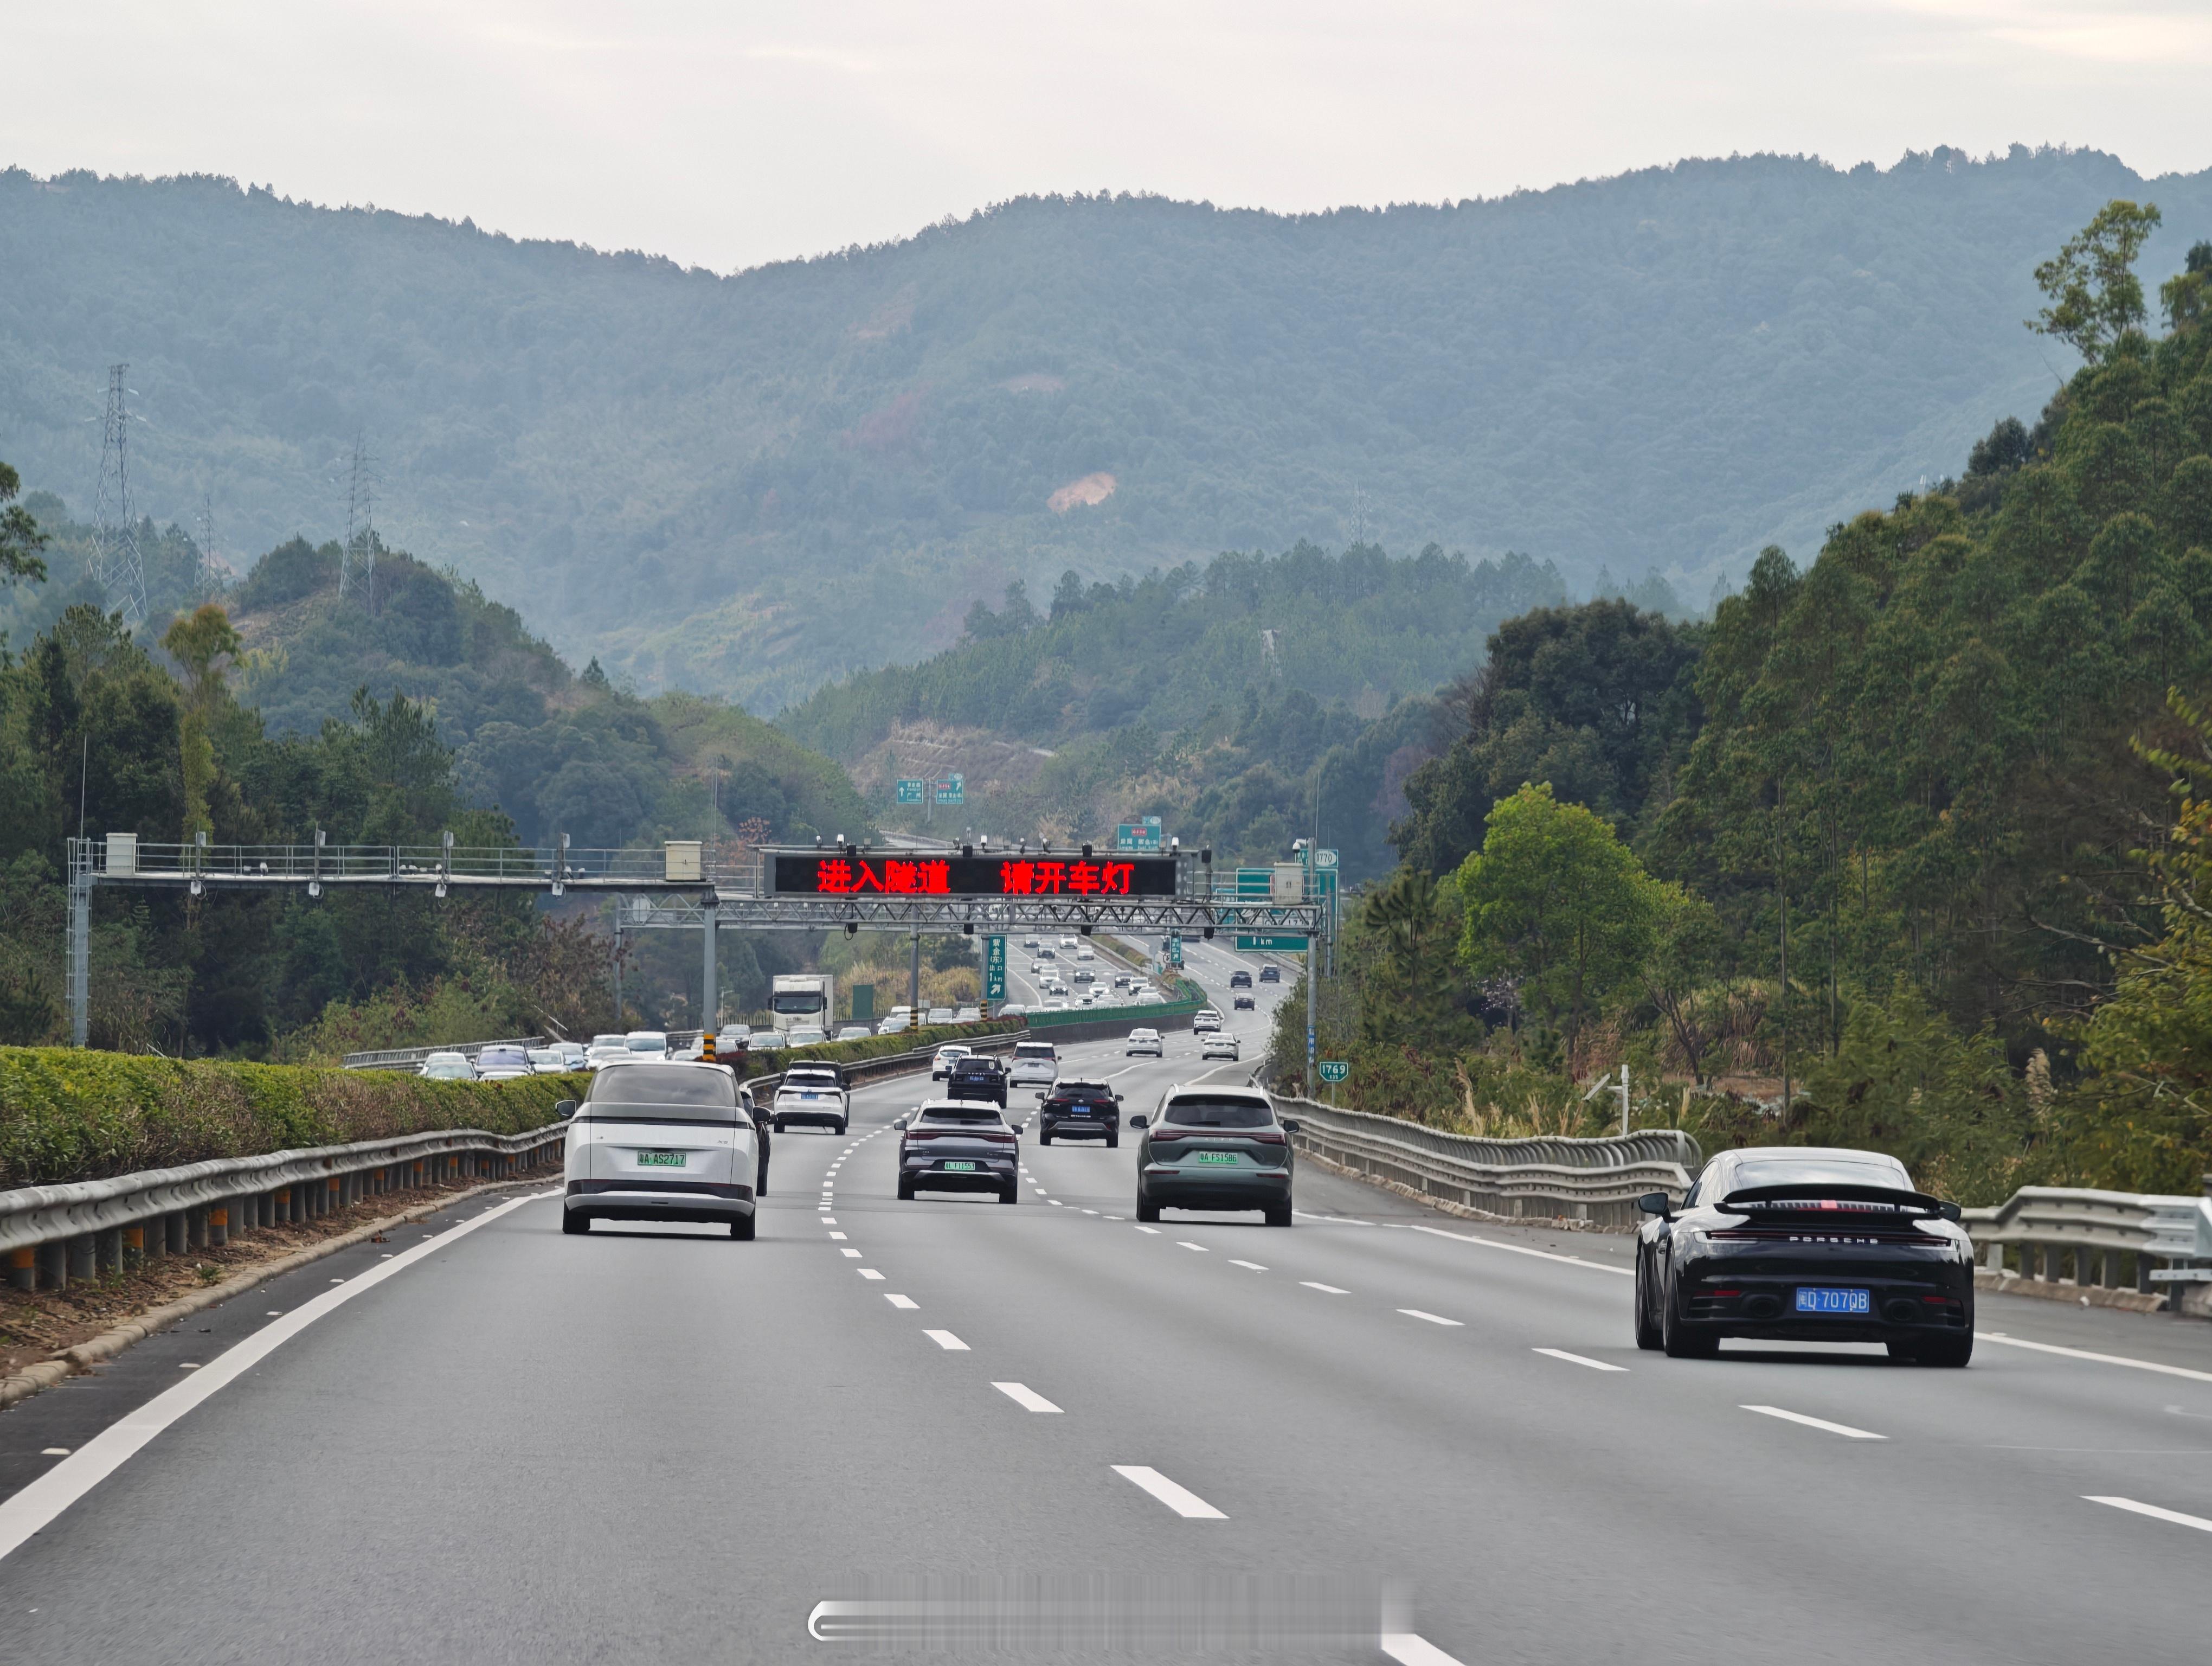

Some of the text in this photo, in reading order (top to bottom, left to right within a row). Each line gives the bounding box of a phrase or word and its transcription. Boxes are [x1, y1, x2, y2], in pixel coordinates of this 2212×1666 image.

[1316, 853, 1332, 863] 1770
[817, 860, 1135, 895] 进入隧道 请开车灯
[1322, 1065, 1346, 1074] 1769
